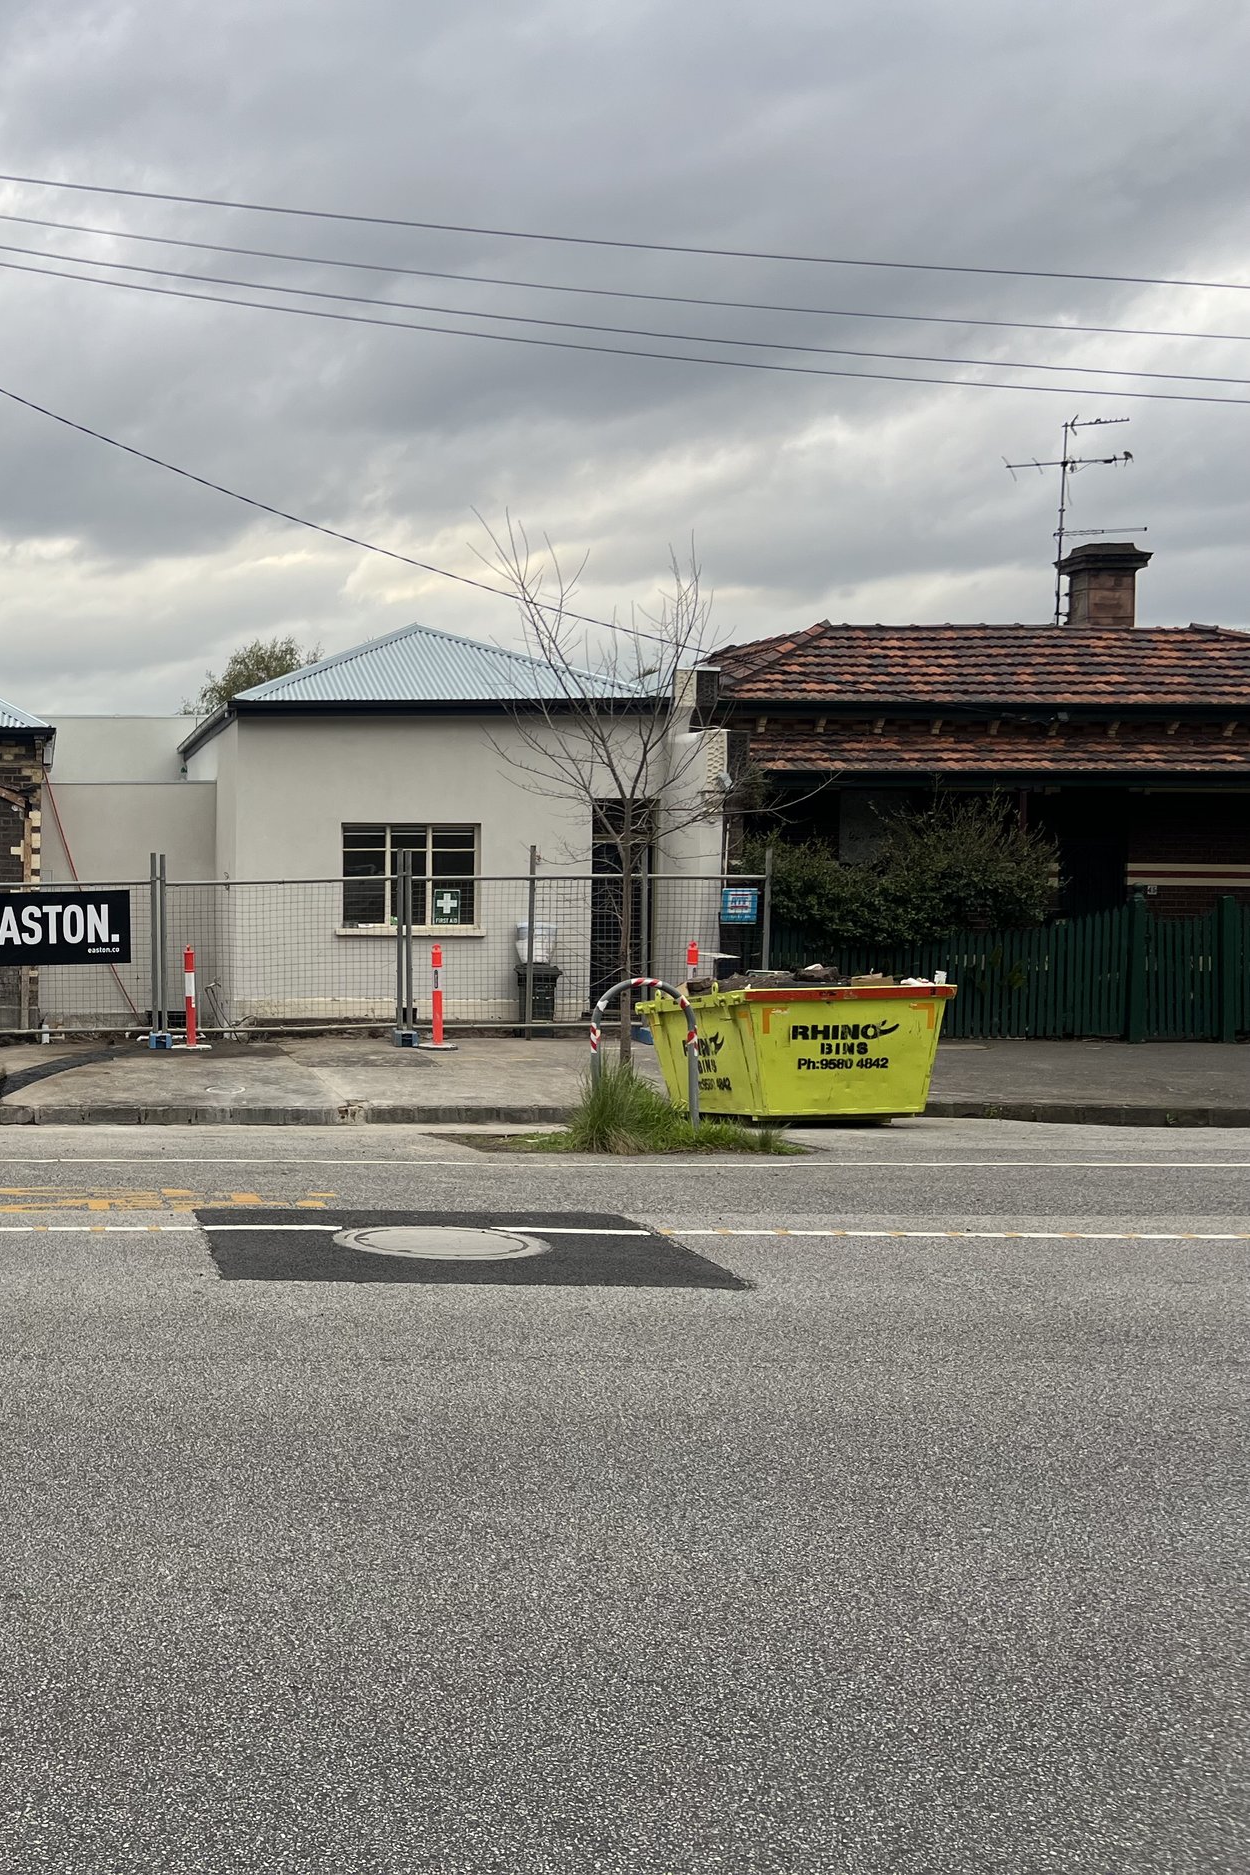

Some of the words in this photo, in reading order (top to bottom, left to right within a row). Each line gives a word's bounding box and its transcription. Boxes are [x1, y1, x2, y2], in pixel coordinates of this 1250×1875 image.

[87, 946, 120, 954] easton.co
[792, 1023, 879, 1040] RHINO
[820, 1042, 868, 1055] BINS
[856, 1057, 889, 1069] 4842
